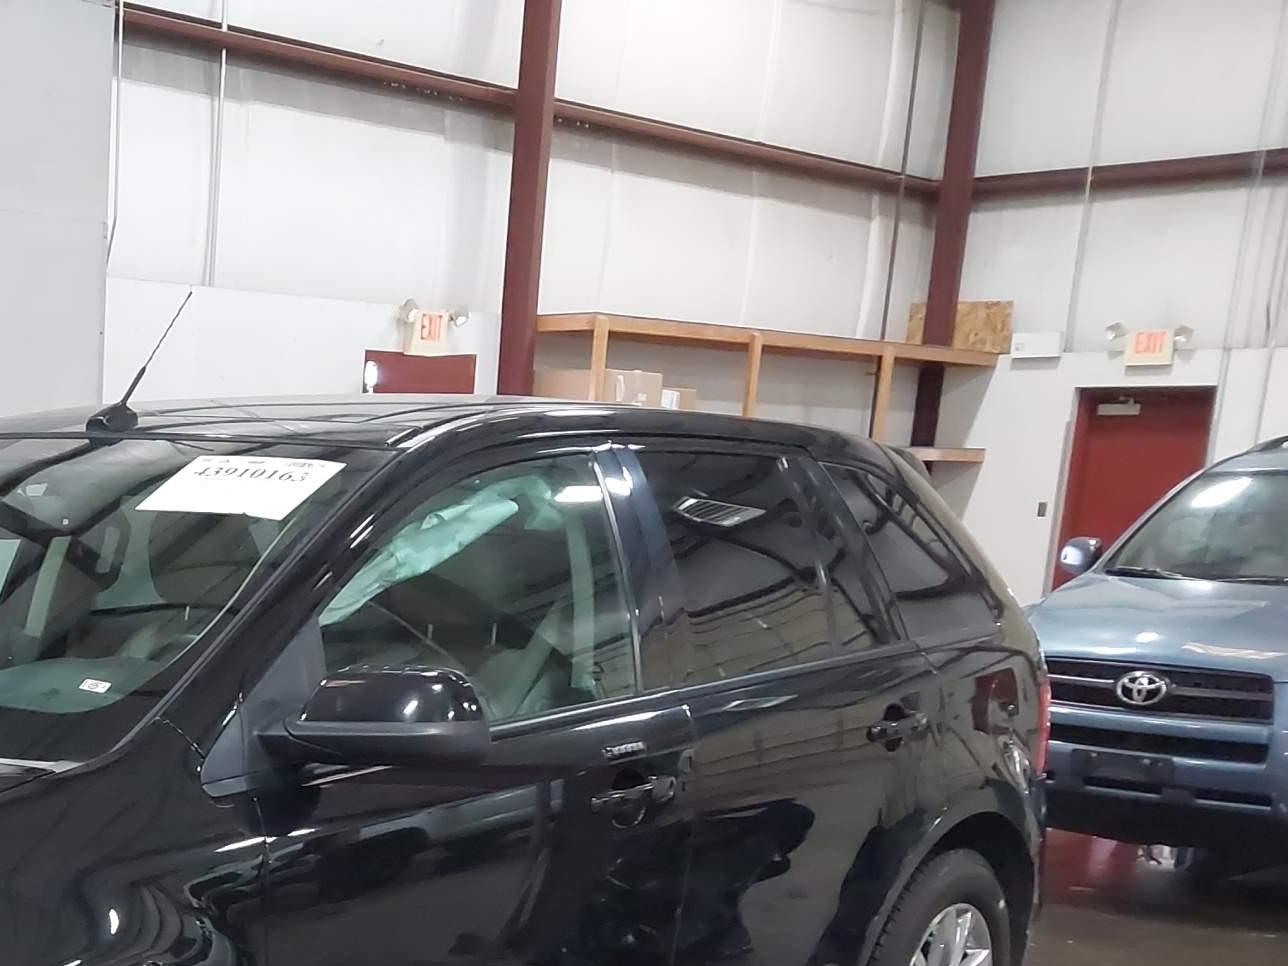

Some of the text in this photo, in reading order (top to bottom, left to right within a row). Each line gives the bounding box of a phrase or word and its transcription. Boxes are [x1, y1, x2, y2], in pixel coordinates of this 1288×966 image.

[420, 313, 442, 341] EXIT
[1135, 331, 1166, 354] EXIT
[193, 467, 310, 482] 43910163
